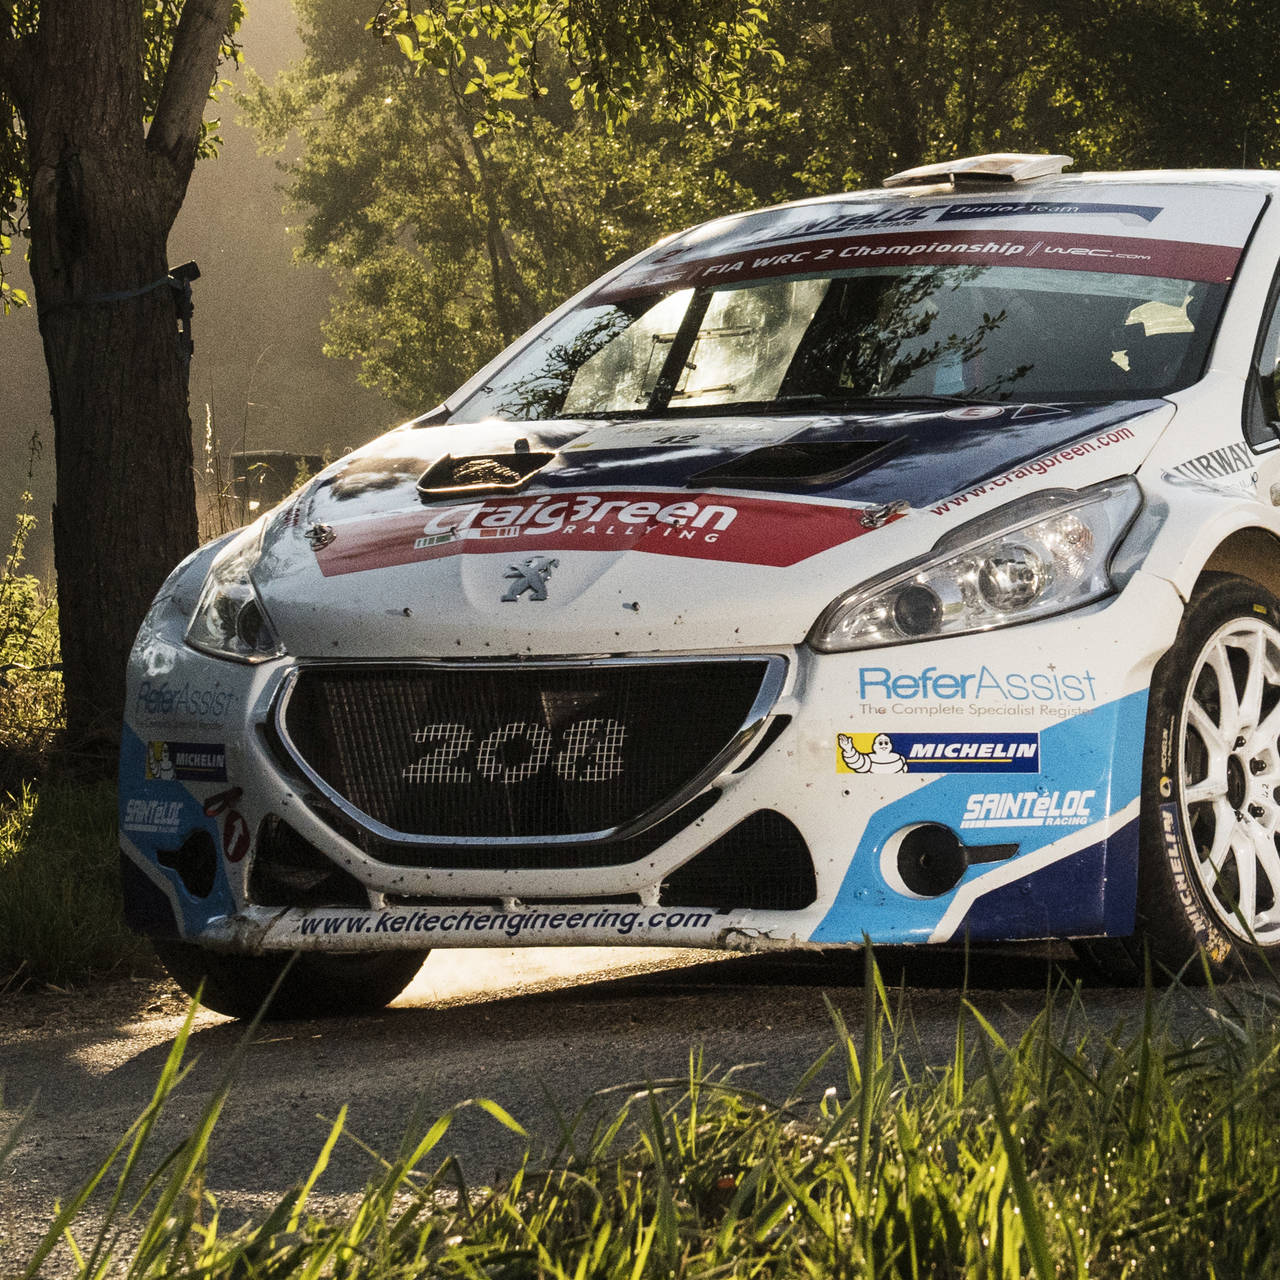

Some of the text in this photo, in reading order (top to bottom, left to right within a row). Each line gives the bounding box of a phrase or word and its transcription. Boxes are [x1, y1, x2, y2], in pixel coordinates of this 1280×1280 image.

[951, 205, 1080, 214] Junior Team
[702, 242, 1025, 277] FIA WRC 2 Championship
[652, 434, 701, 445] 42
[929, 425, 1135, 517] www.craigbreen.com
[563, 523, 720, 543] RALLYING
[858, 665, 1096, 701] ReferAssist
[859, 703, 1095, 718] The Complete Specialist Register
[402, 718, 628, 784] 208
[909, 743, 1037, 758] MICHELIN
[176, 752, 225, 768] MICHELIN
[1045, 817, 1088, 826] RACING
[300, 909, 713, 937] www.keltechengineering.com
